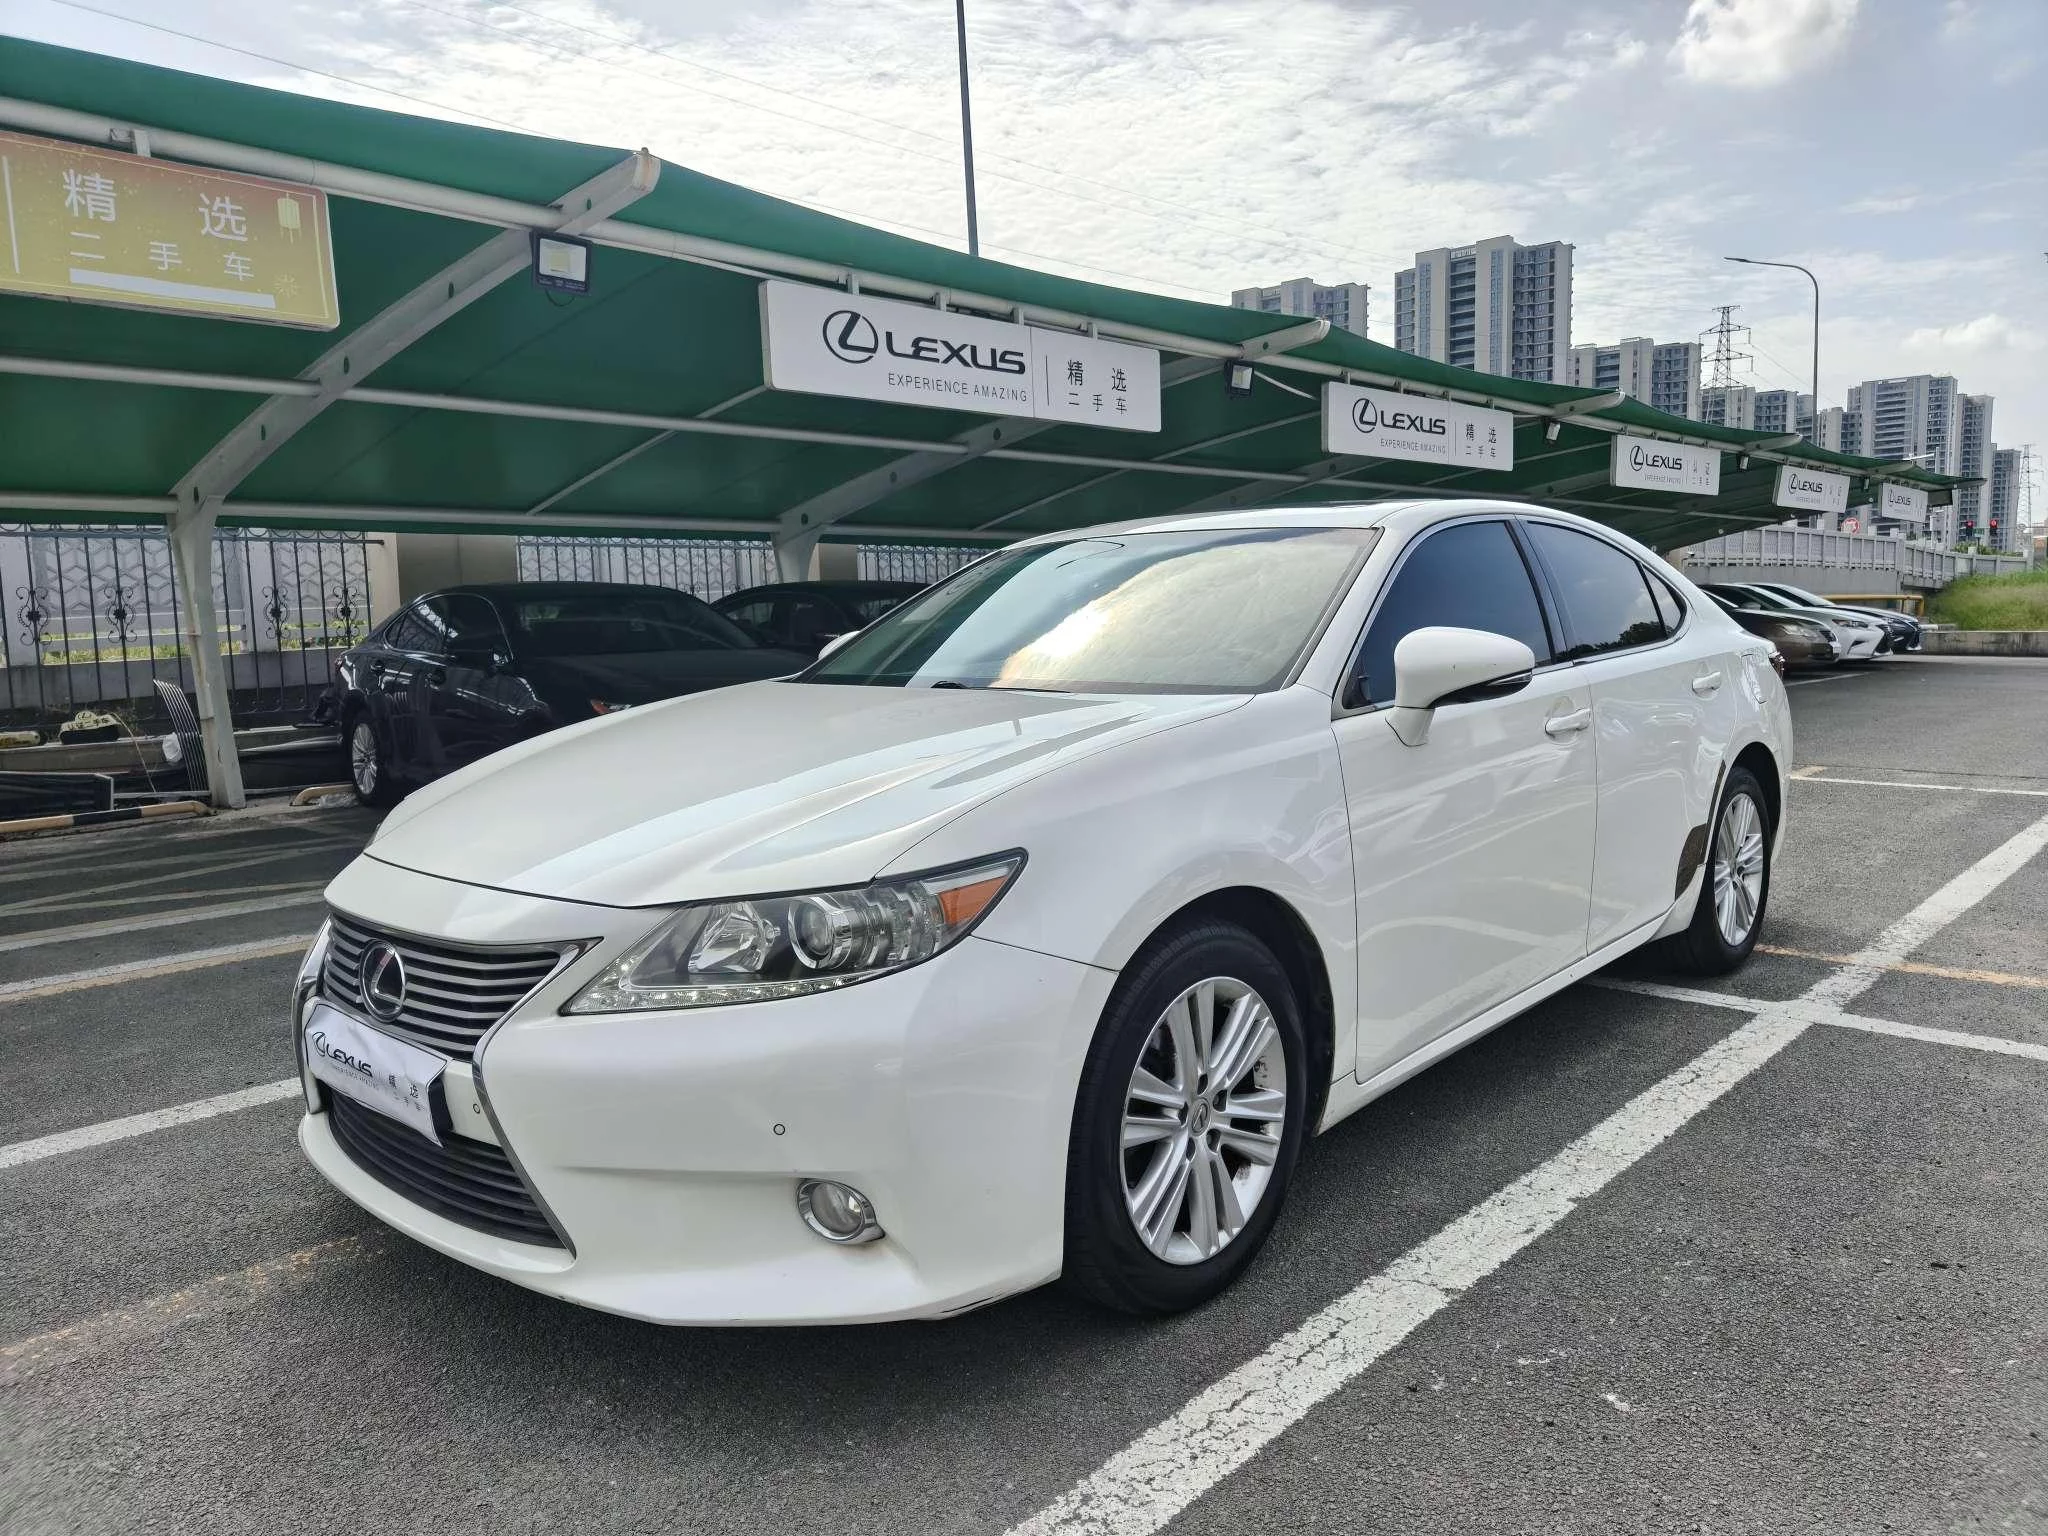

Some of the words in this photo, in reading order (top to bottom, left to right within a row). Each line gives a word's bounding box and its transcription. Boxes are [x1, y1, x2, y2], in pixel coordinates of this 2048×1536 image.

[62, 168, 249, 242] 精选
[69, 231, 254, 281] 二手车
[886, 331, 1026, 375] LEXUS
[888, 372, 968, 395] EXPERIENCE
[973, 384, 1027, 402] AMAZING
[1067, 359, 1127, 392] 精选
[1068, 392, 1127, 416] 二手车
[1380, 410, 1446, 436] LEXUS
[1380, 438, 1418, 452] EXPERIENCE
[1645, 453, 1682, 470] LEXUS
[1798, 480, 1823, 493] LEXUS
[326, 1043, 373, 1078] LEXUS
